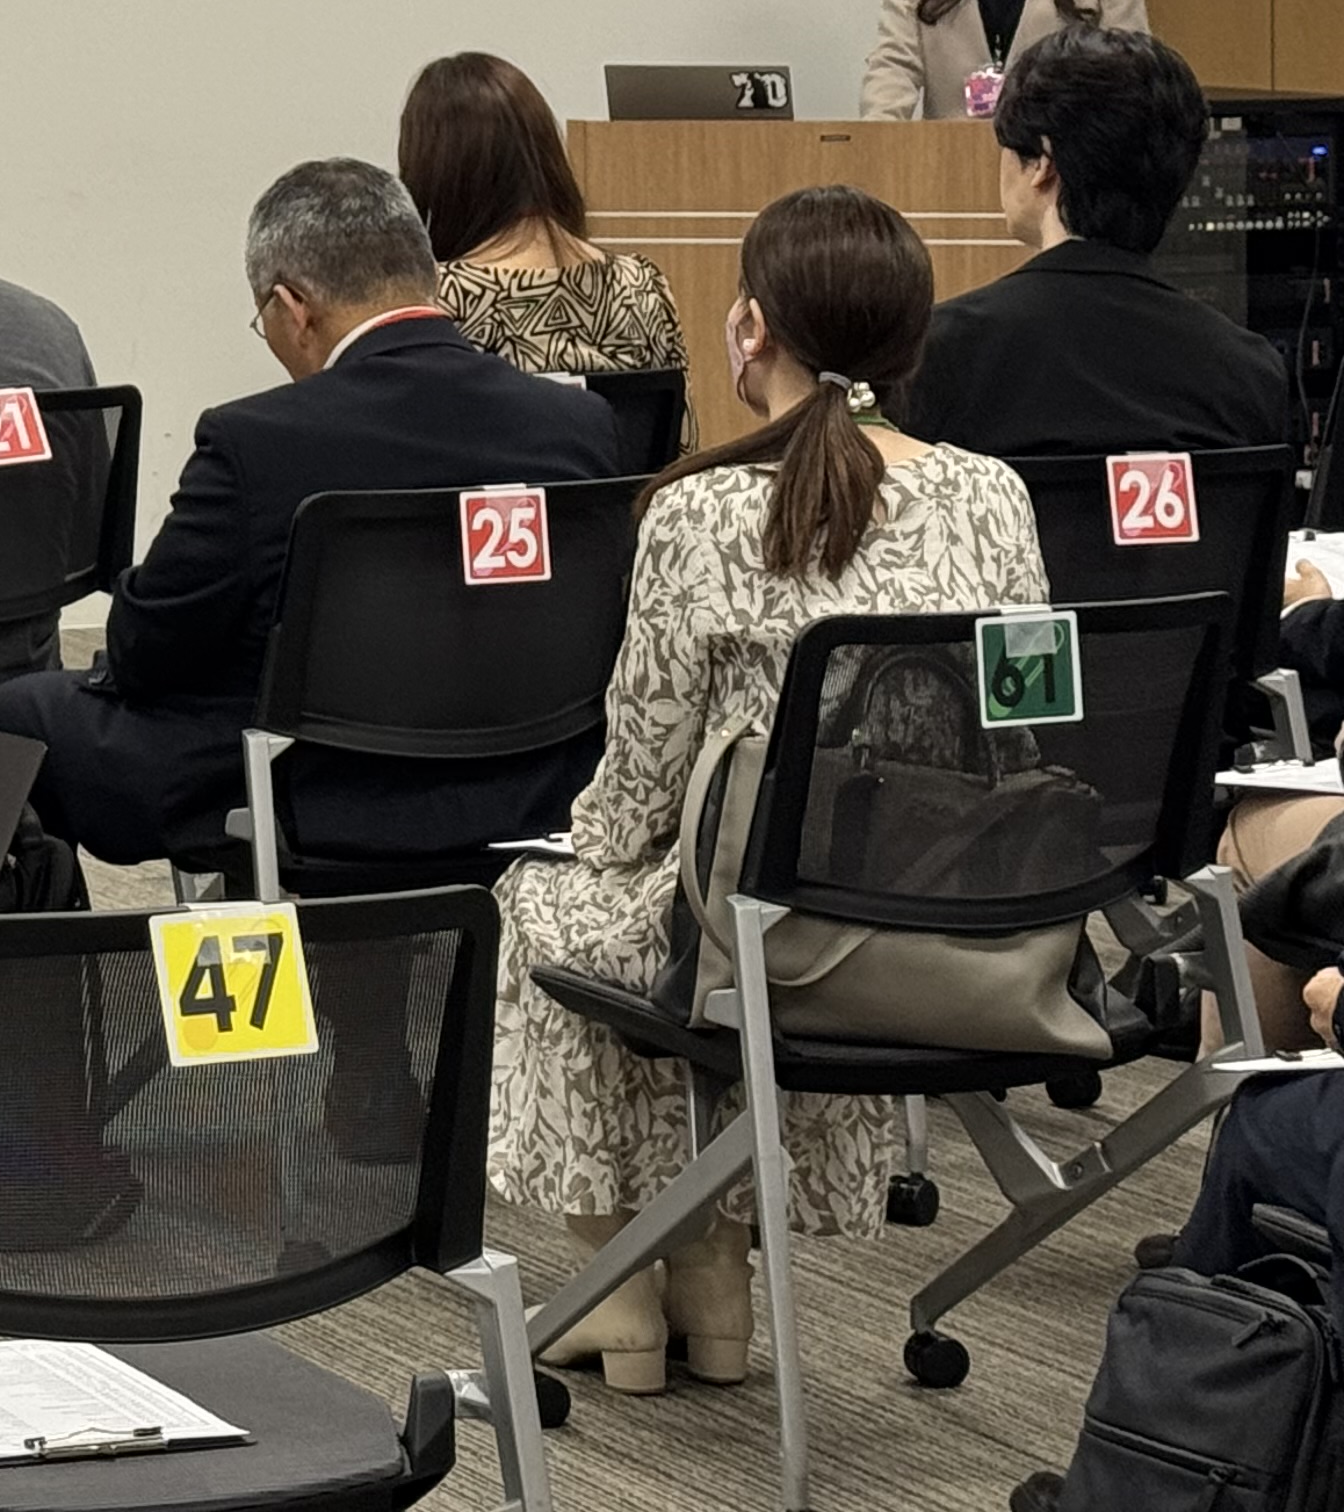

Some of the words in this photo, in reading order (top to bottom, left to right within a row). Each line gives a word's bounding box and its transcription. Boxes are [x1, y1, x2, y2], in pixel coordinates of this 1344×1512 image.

[1119, 469, 1185, 529] 26
[472, 507, 538, 570] 25
[992, 638, 1056, 708] 61
[179, 931, 284, 1033] 47
